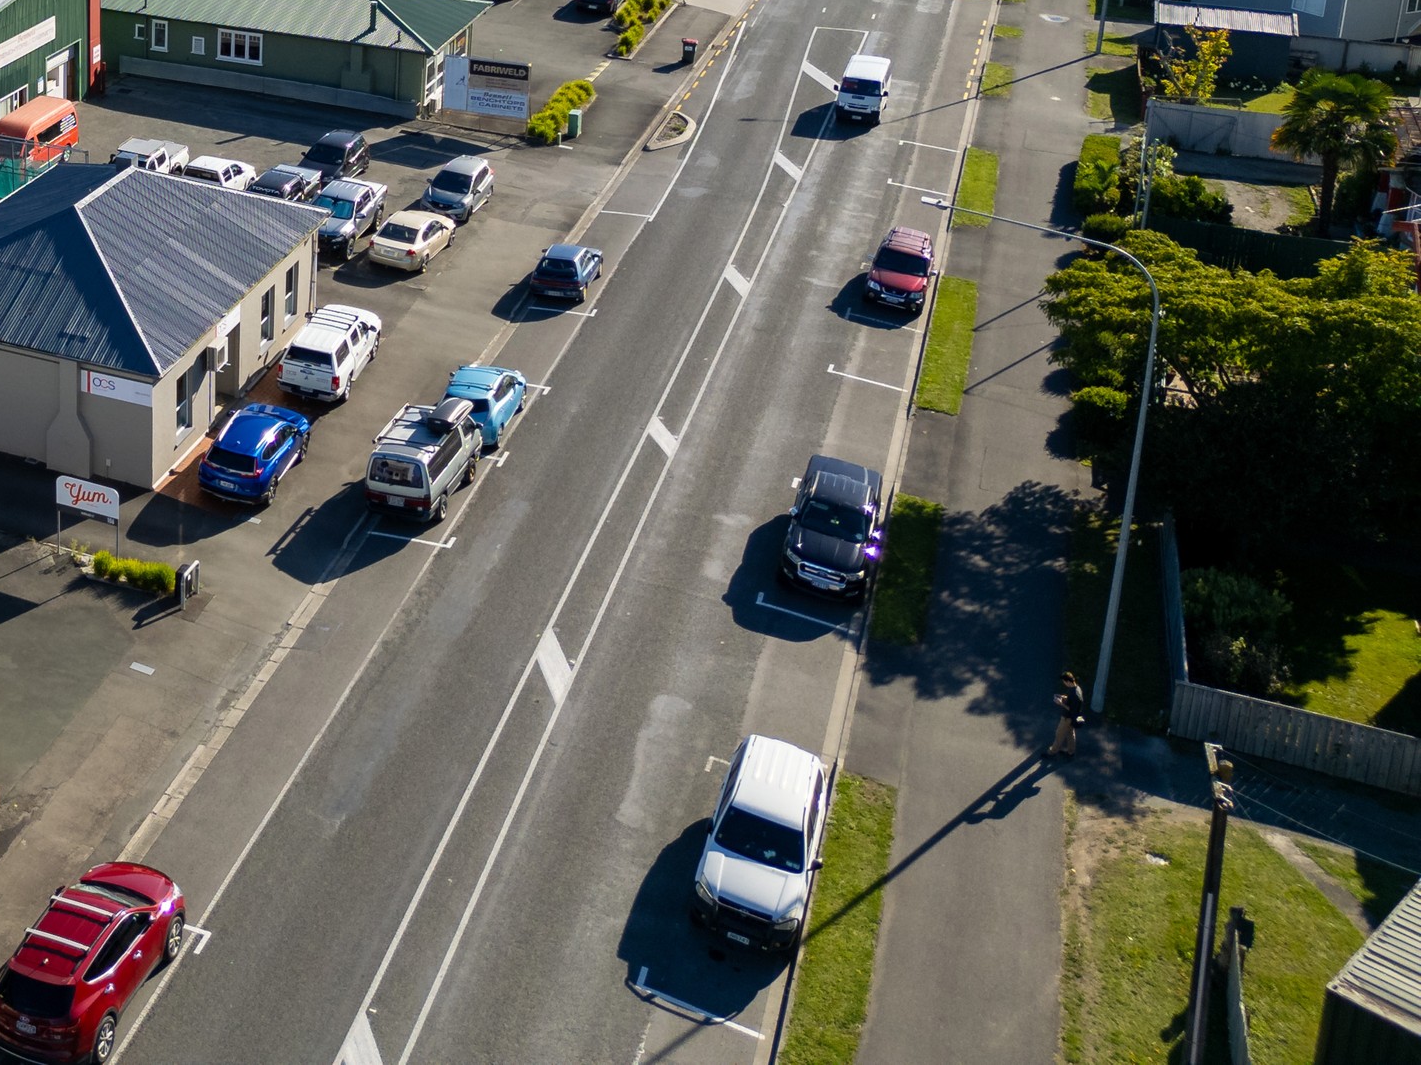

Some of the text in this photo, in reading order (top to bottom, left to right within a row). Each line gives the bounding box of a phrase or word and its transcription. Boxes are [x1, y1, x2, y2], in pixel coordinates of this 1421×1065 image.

[473, 64, 526, 76] FABRIWELD
[470, 96, 525, 106] BENCHTOPS
[484, 92, 513, 100] Bennett
[478, 102, 523, 112] CABINETS
[252, 185, 280, 194] TOYOTA
[92, 377, 116, 391] OCS
[64, 481, 112, 505] Yum.
